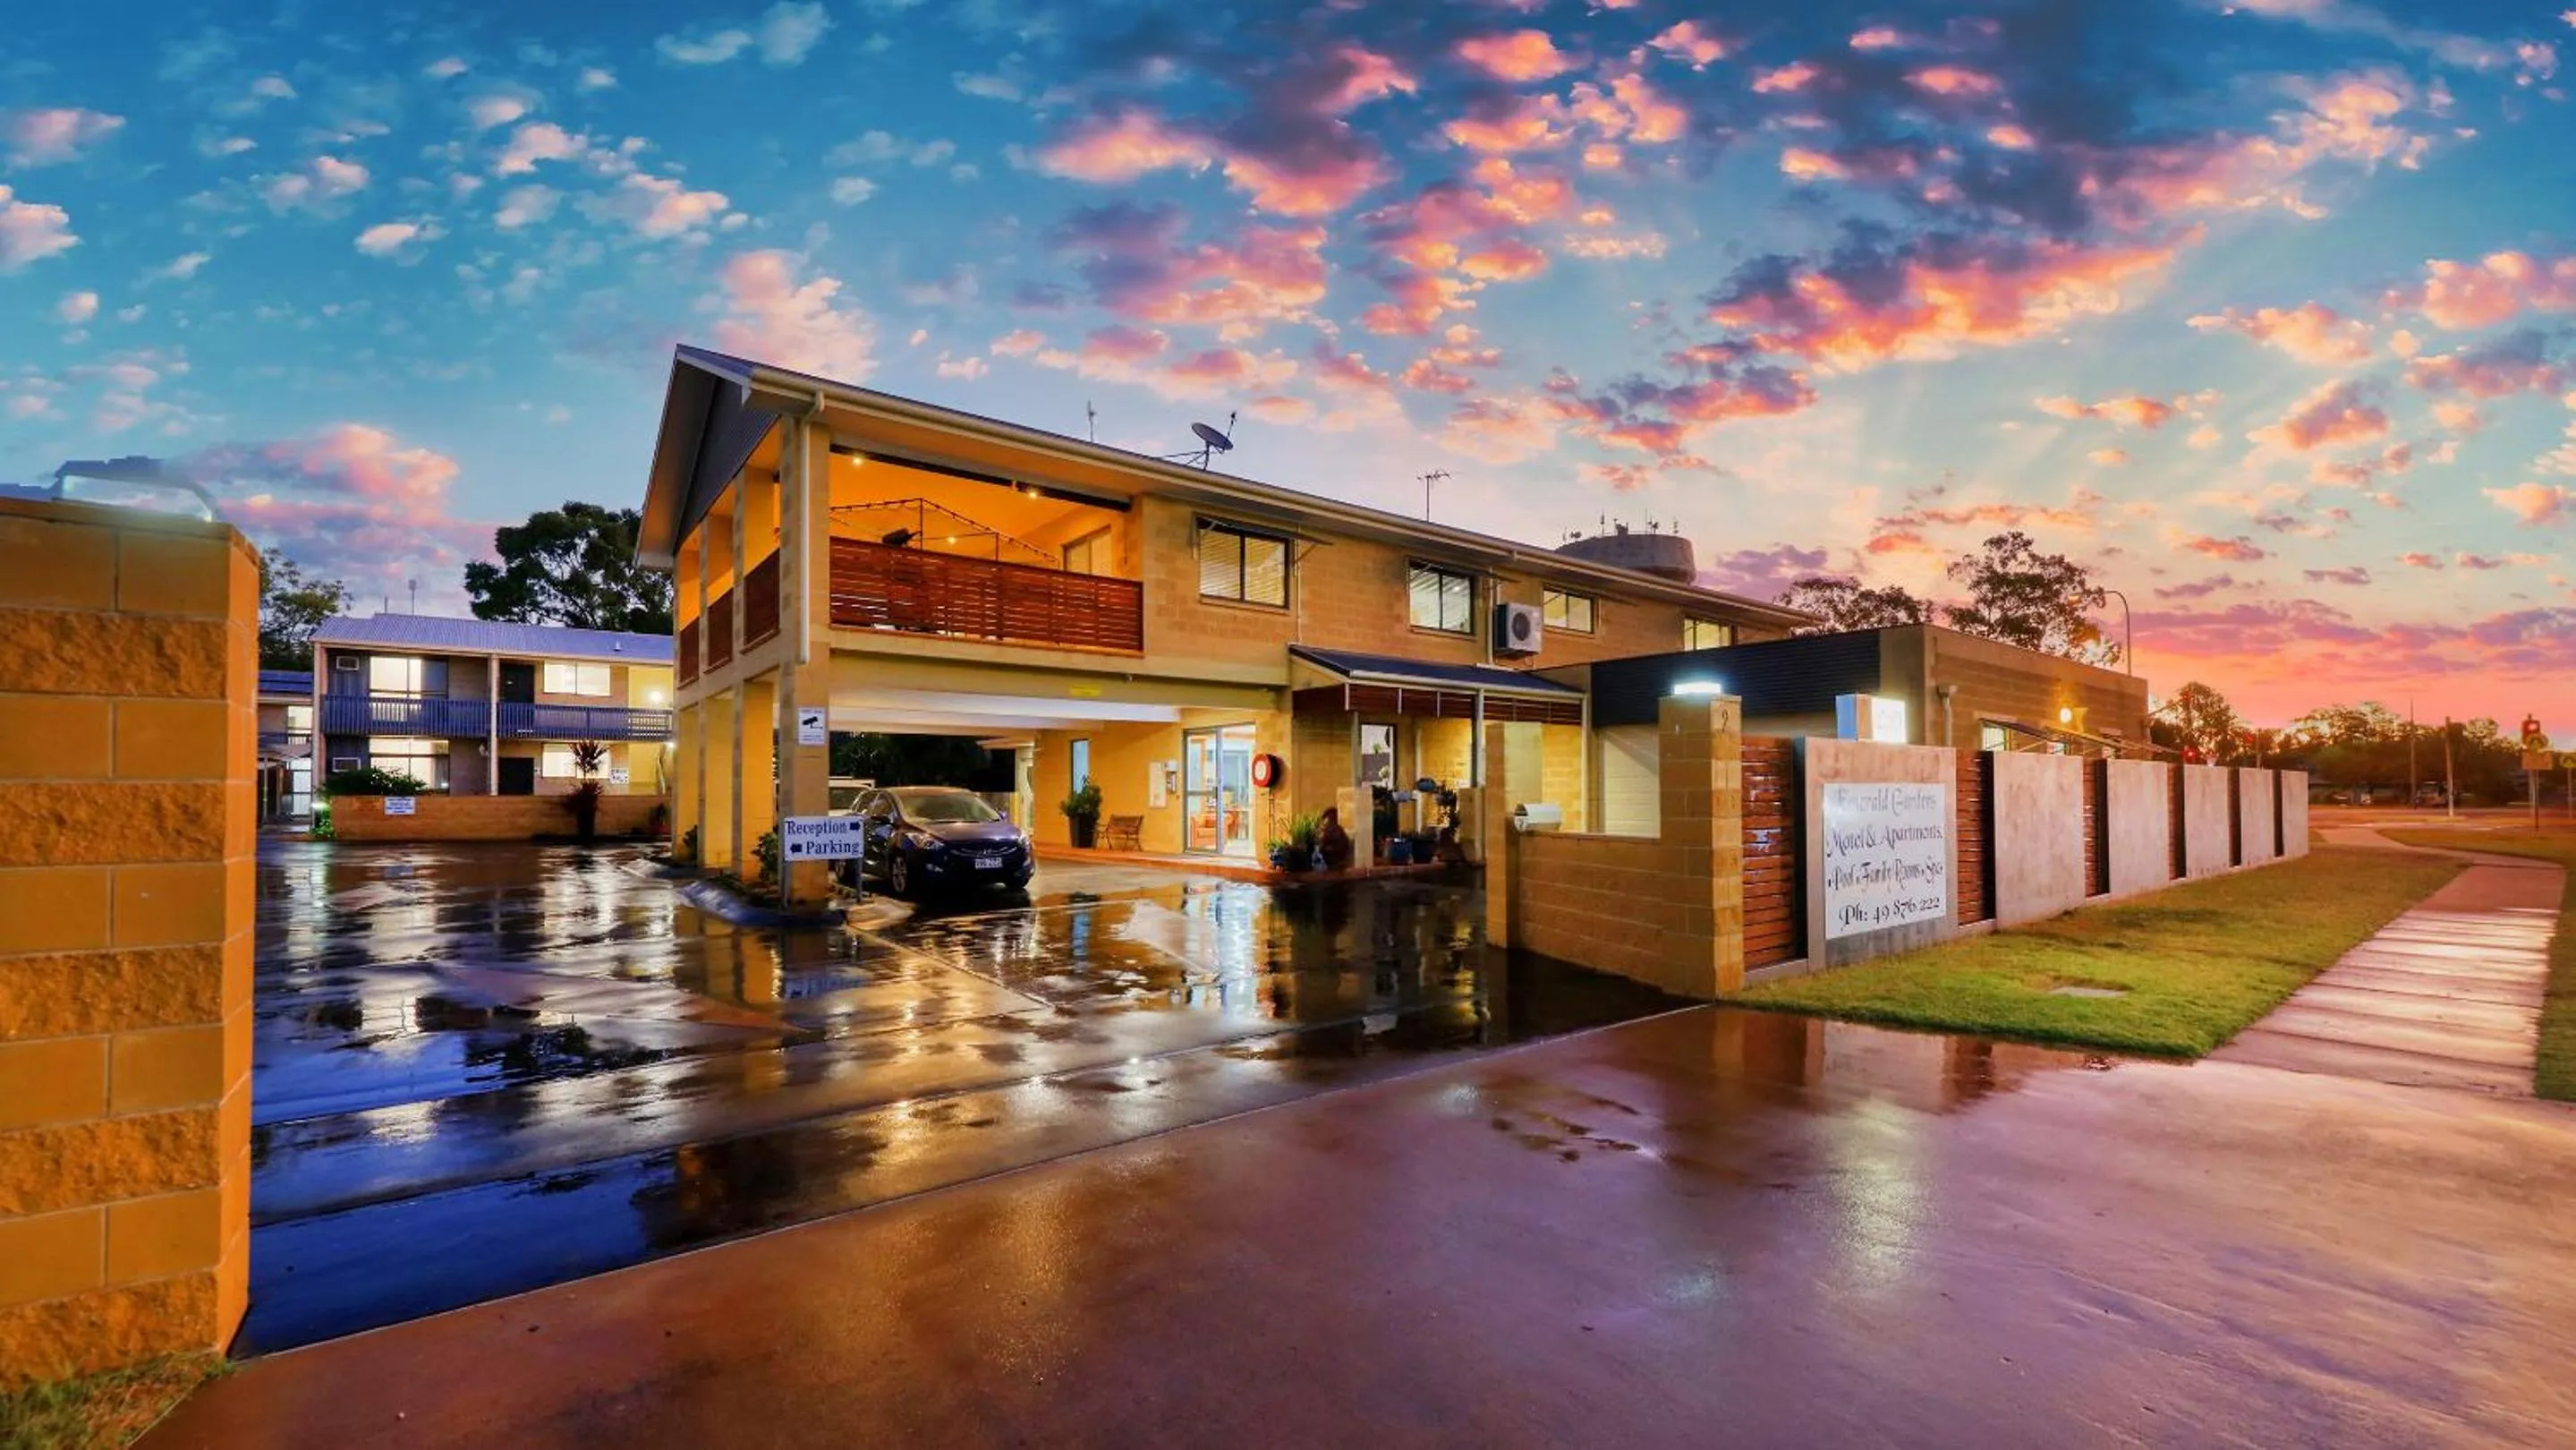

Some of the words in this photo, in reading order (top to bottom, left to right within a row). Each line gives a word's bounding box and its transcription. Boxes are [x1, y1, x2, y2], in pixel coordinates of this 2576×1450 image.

[785, 820, 847, 837] Reception
[806, 840, 860, 856] Parking
[1826, 825, 1865, 857] Motel
[1839, 902, 1868, 925] Ph:
[1873, 905, 1890, 924] 49
[1893, 899, 1916, 919] 876
[1919, 897, 1940, 911] 222
